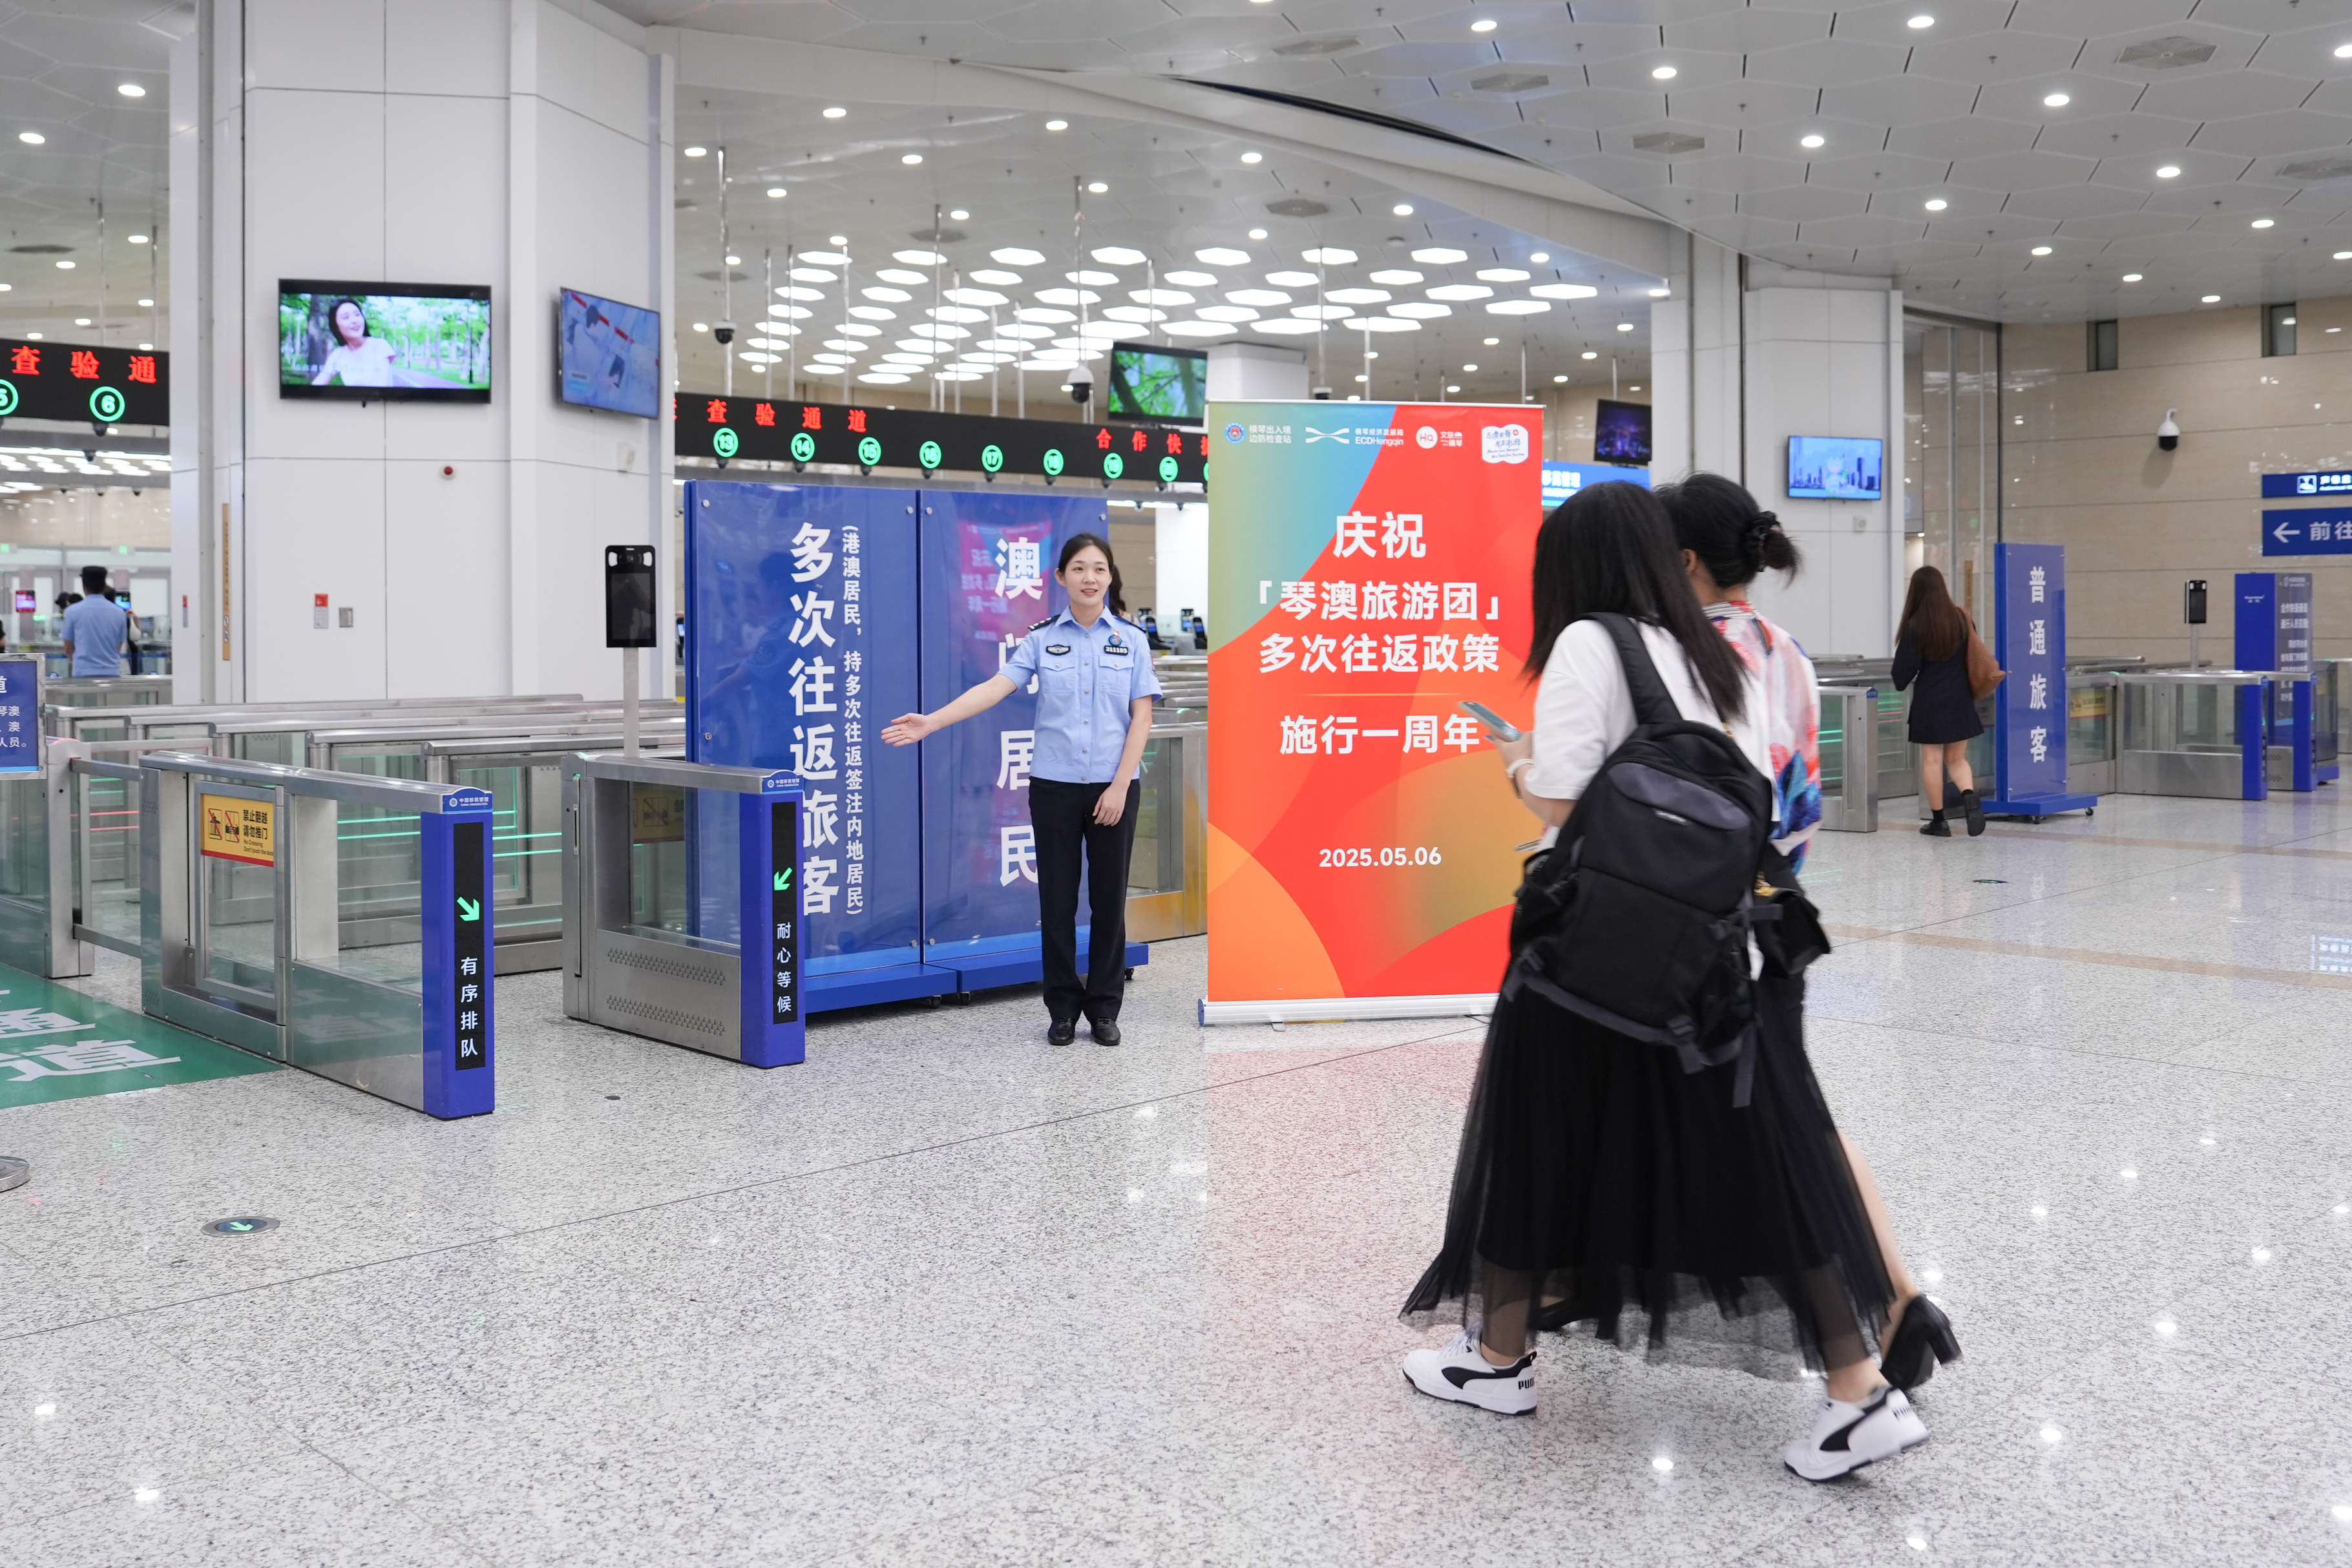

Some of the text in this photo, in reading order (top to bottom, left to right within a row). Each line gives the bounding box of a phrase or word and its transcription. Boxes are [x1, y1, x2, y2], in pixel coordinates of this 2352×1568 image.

[11, 346, 157, 383] 查验通
[101, 395, 115, 413] 6
[674, 398, 867, 433] 查验通道
[719, 434, 734, 450] 13
[797, 440, 810, 454] 14
[1249, 434, 1292, 443] 边防检查站
[1355, 437, 1403, 446] ECDHengqin
[864, 444, 877, 458] 15
[925, 448, 937, 461] 16
[987, 452, 998, 465] 17
[1332, 510, 1427, 559] 庆祝
[2309, 521, 2352, 541] 前往
[1258, 581, 1500, 622] 「琴澳旅游团」
[1259, 633, 1500, 674] 多次往返政策
[2029, 565, 2047, 764] 普通旅客
[788, 522, 839, 916] 多次往返旅客
[1279, 714, 1480, 755] 施行一周年
[243, 810, 268, 824] 禁止翻越
[244, 825, 268, 839] 请勿推门
[1318, 847, 1442, 867] 2025.05.06
[777, 922, 792, 1014] 耐心等候
[460, 956, 479, 1058] 有序排队
[1518, 1377, 1535, 1390] PUM
